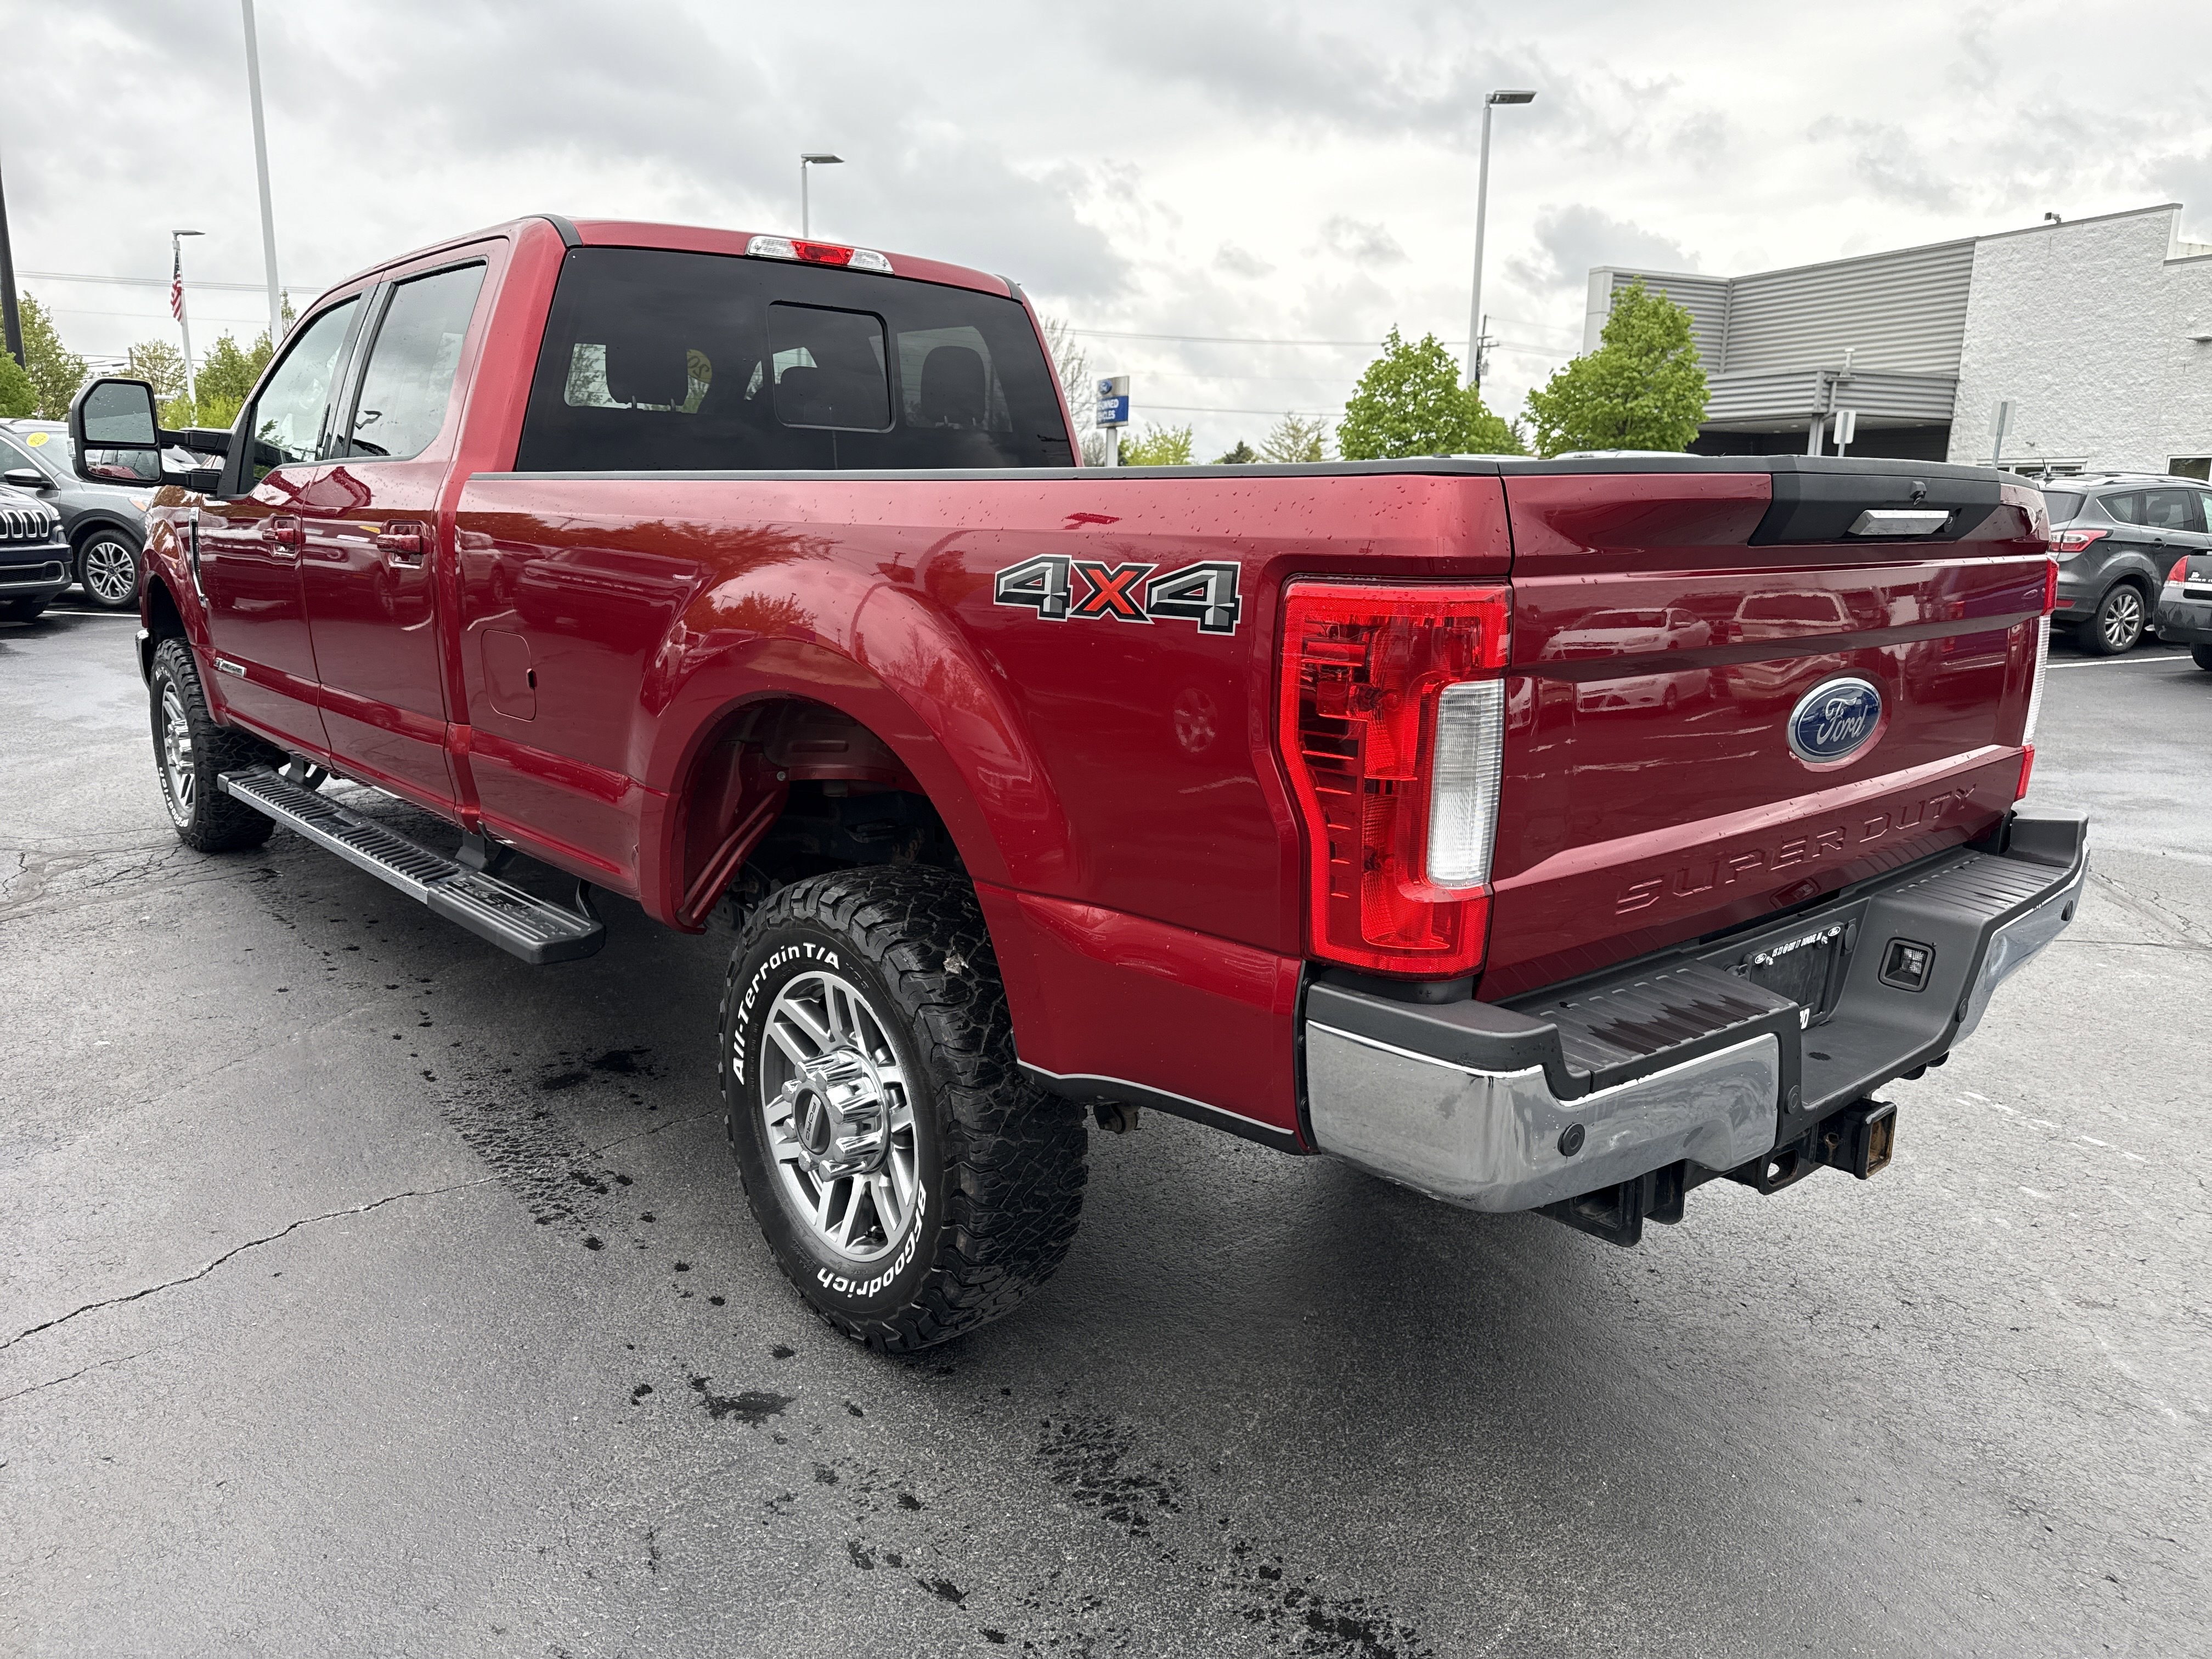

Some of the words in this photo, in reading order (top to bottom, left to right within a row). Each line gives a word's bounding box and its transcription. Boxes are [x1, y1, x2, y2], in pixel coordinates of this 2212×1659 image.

[1816, 697, 1868, 745] Ford
[159, 767, 189, 827] BFGoodrich
[1616, 827, 1847, 915] SUPER
[1859, 785, 1977, 843] DUTY
[733, 945, 800, 1085] All-Terrain
[803, 942, 839, 970] T/A
[805, 1101, 816, 1141] FORD
[817, 1180, 927, 1298] BFGoodrich
